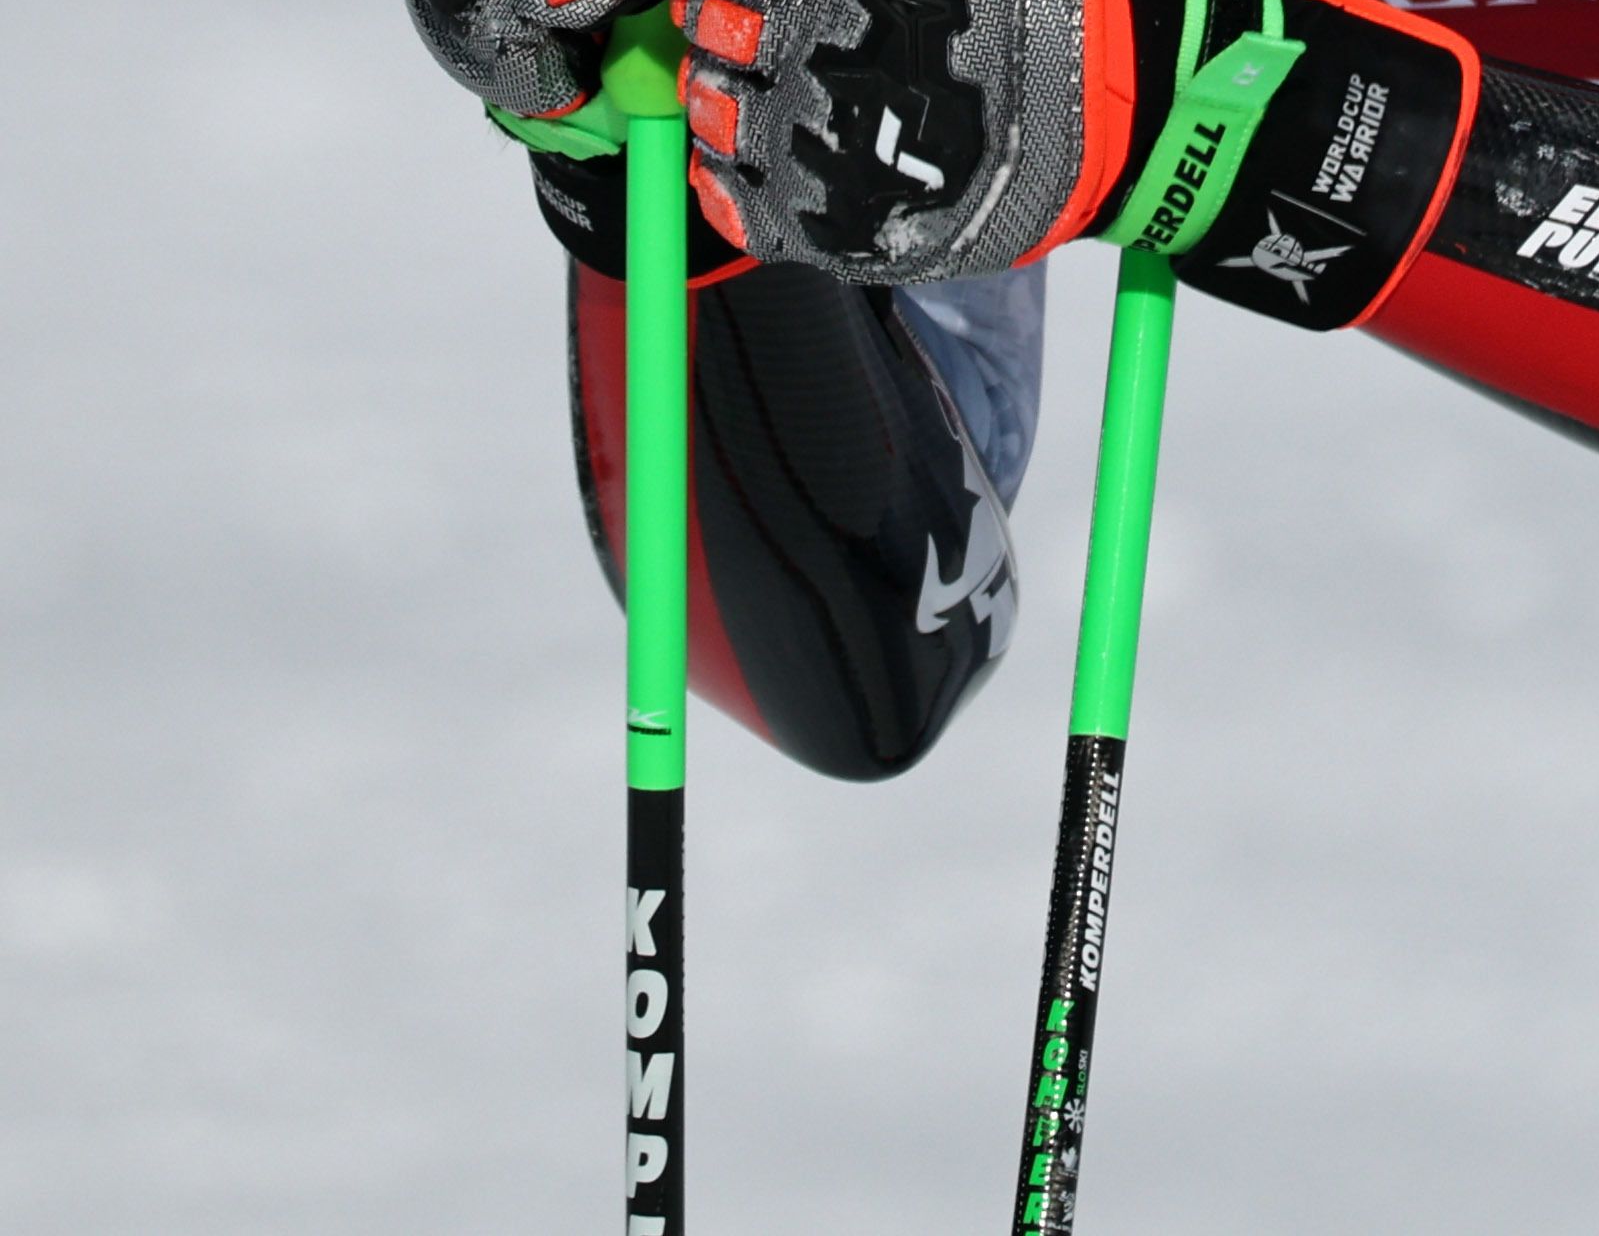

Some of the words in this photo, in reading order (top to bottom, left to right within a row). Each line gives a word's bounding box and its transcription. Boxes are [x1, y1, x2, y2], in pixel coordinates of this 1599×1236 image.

[1311, 73, 1365, 193] WORLDCUP
[1079, 771, 1121, 993] KOMPERDELL
[1021, 998, 1076, 1236] KOMPER
